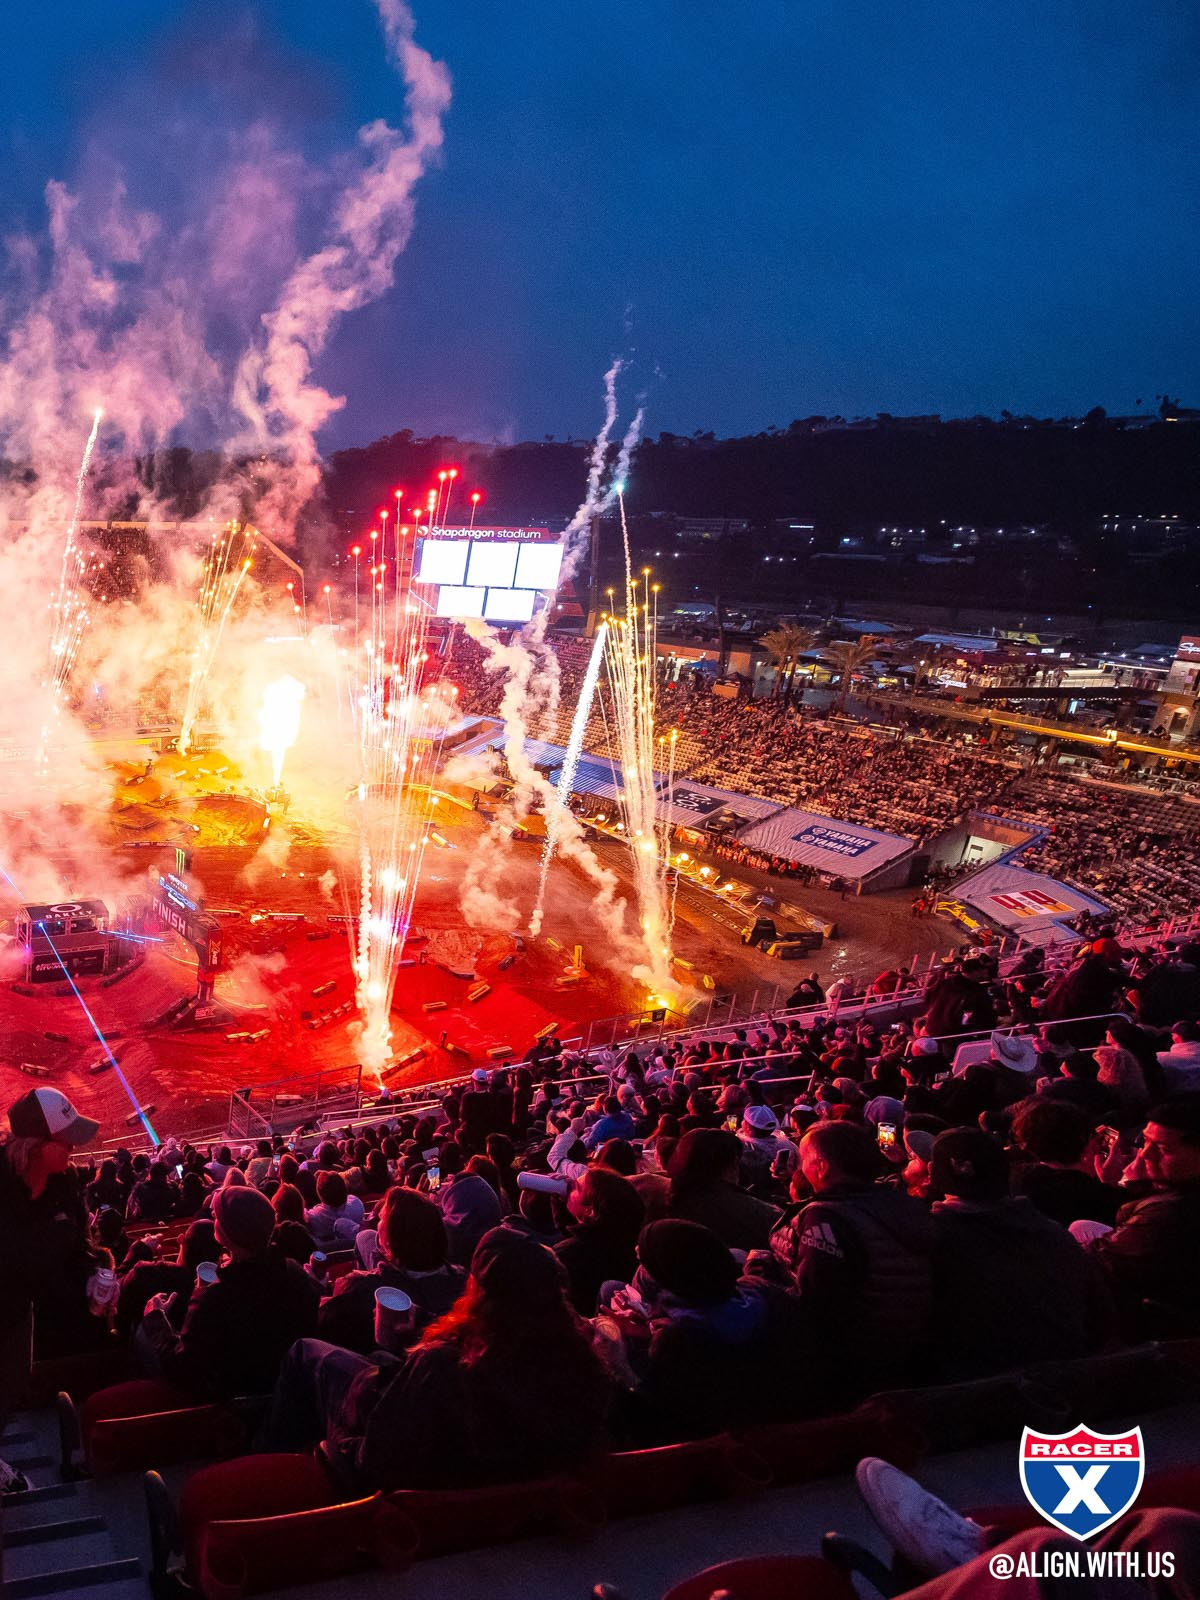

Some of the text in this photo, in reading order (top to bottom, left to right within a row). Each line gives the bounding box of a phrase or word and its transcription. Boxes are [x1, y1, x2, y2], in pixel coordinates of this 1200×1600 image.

[431, 526, 541, 539] Snapdragon stadium
[813, 837, 859, 855] YAMAHA
[825, 830, 872, 847] YAMAHA
[45, 910, 93, 919] OAKLEY
[152, 899, 186, 937] FINISH
[801, 1235, 844, 1258] adidas
